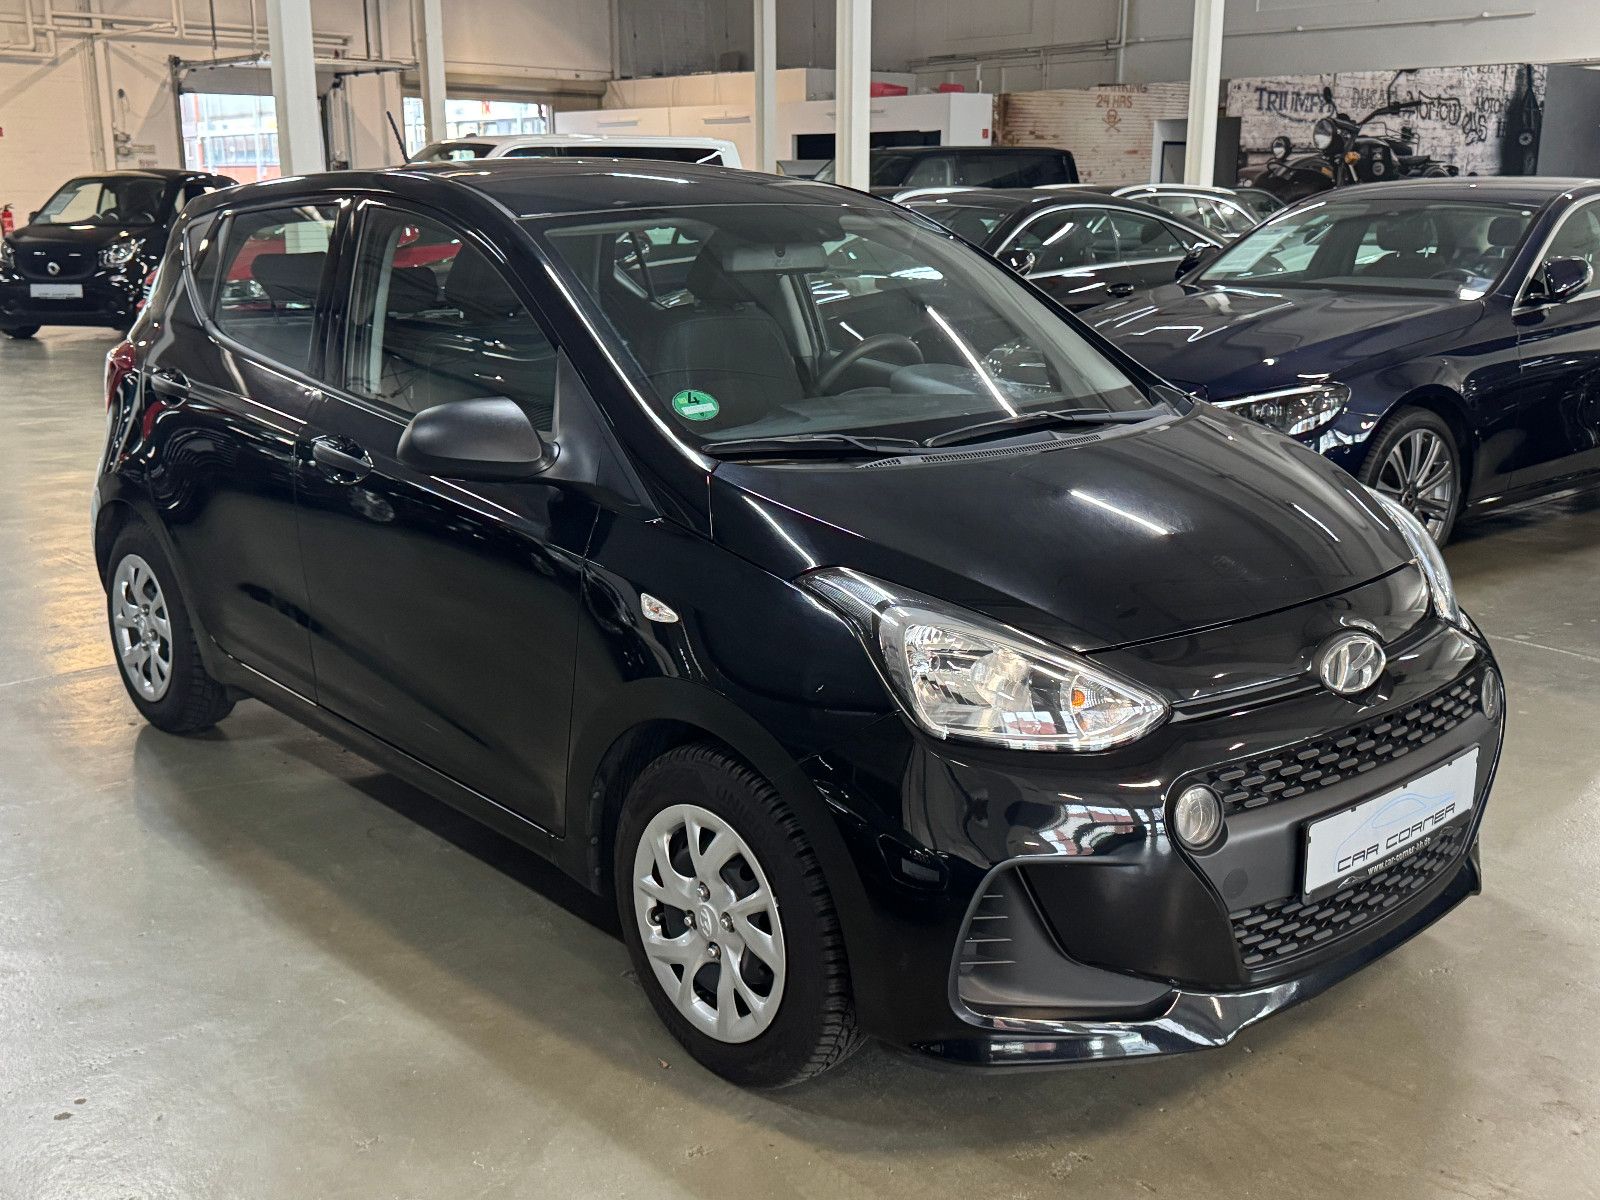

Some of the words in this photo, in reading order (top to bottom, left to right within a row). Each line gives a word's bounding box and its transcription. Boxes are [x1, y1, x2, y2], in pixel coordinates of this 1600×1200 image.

[1096, 94, 1109, 108] 24
[1112, 95, 1133, 109] HRS
[1254, 86, 1333, 113] TRIUMPH
[688, 392, 699, 404] 4
[1337, 843, 1379, 872] CAR
[1386, 802, 1455, 849] CORNER
